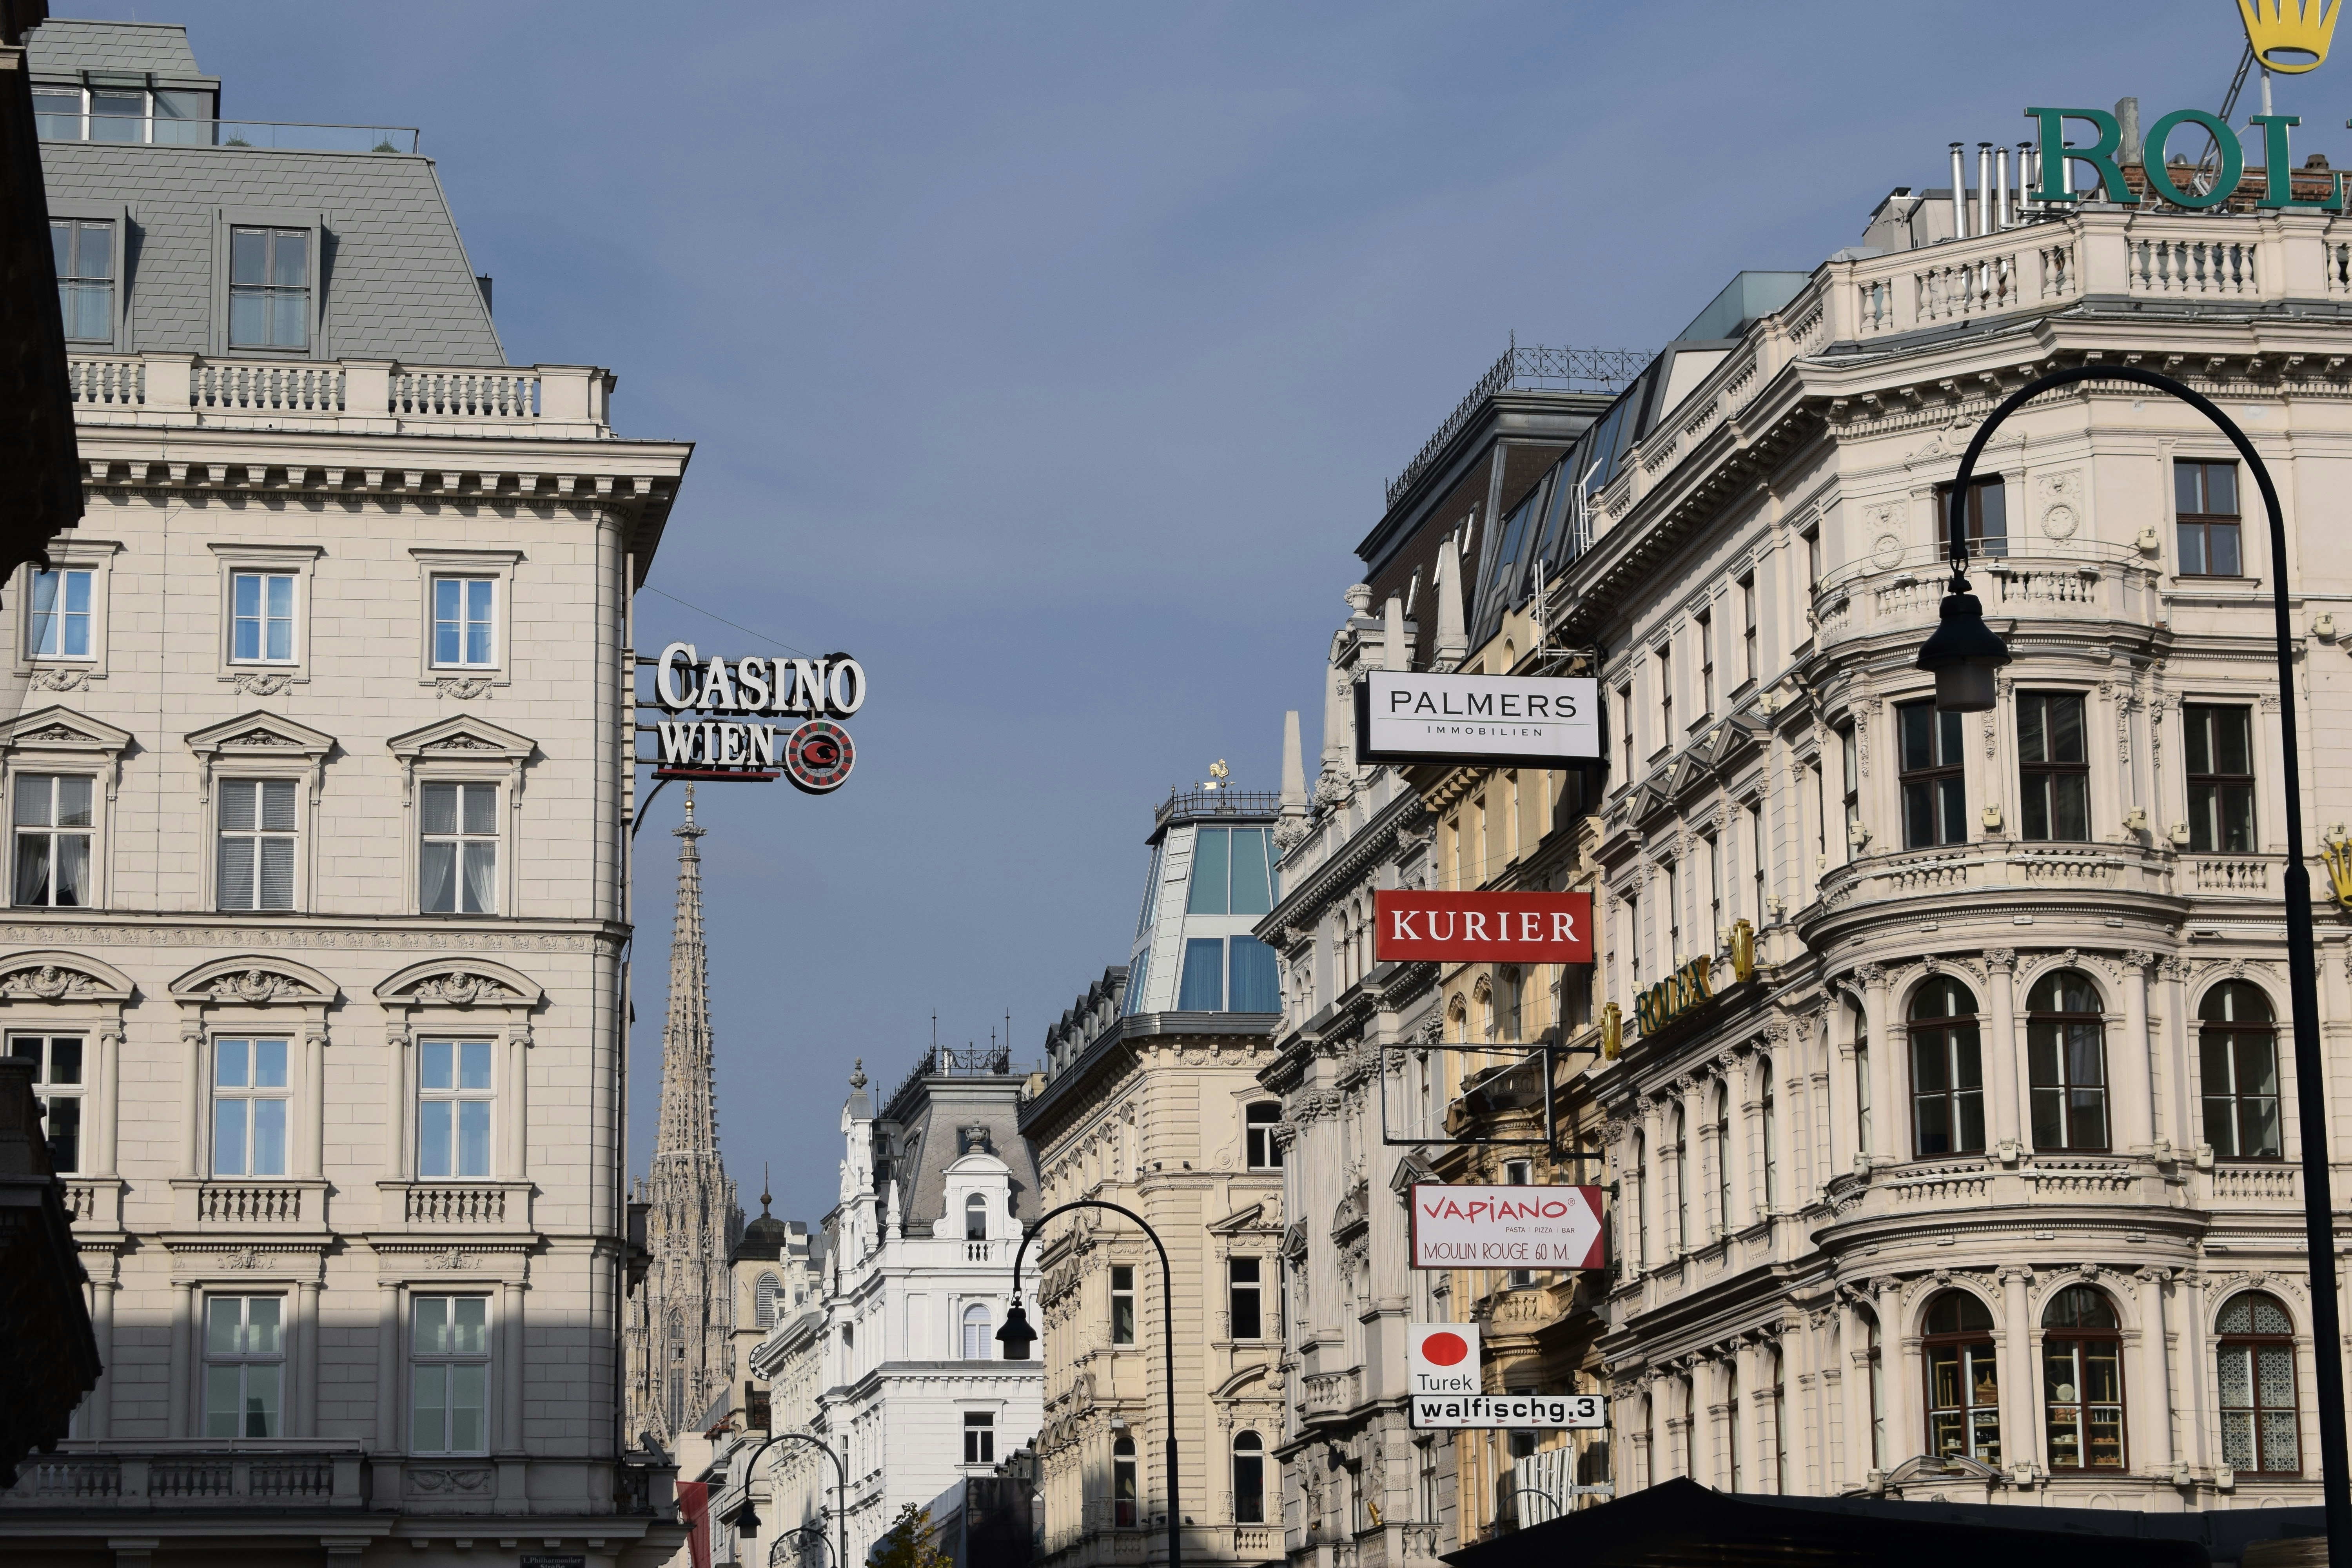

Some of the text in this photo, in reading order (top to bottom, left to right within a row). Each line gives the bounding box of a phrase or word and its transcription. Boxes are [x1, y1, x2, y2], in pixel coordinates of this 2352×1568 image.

[2024, 107, 2352, 210] ROL
[657, 642, 866, 713] CASINO
[1390, 690, 1577, 718] PALMERS
[657, 720, 777, 766] WIEN
[1428, 726, 1543, 736] IMMOBILIEN
[1391, 910, 1580, 942] KURIER
[1637, 954, 1715, 1038] ROLEX
[1424, 1242, 1569, 1260] MOULIN ROUGE 60 M.
[1417, 1374, 1473, 1390] Turek
[1421, 1398, 1595, 1423] walfischg.3
